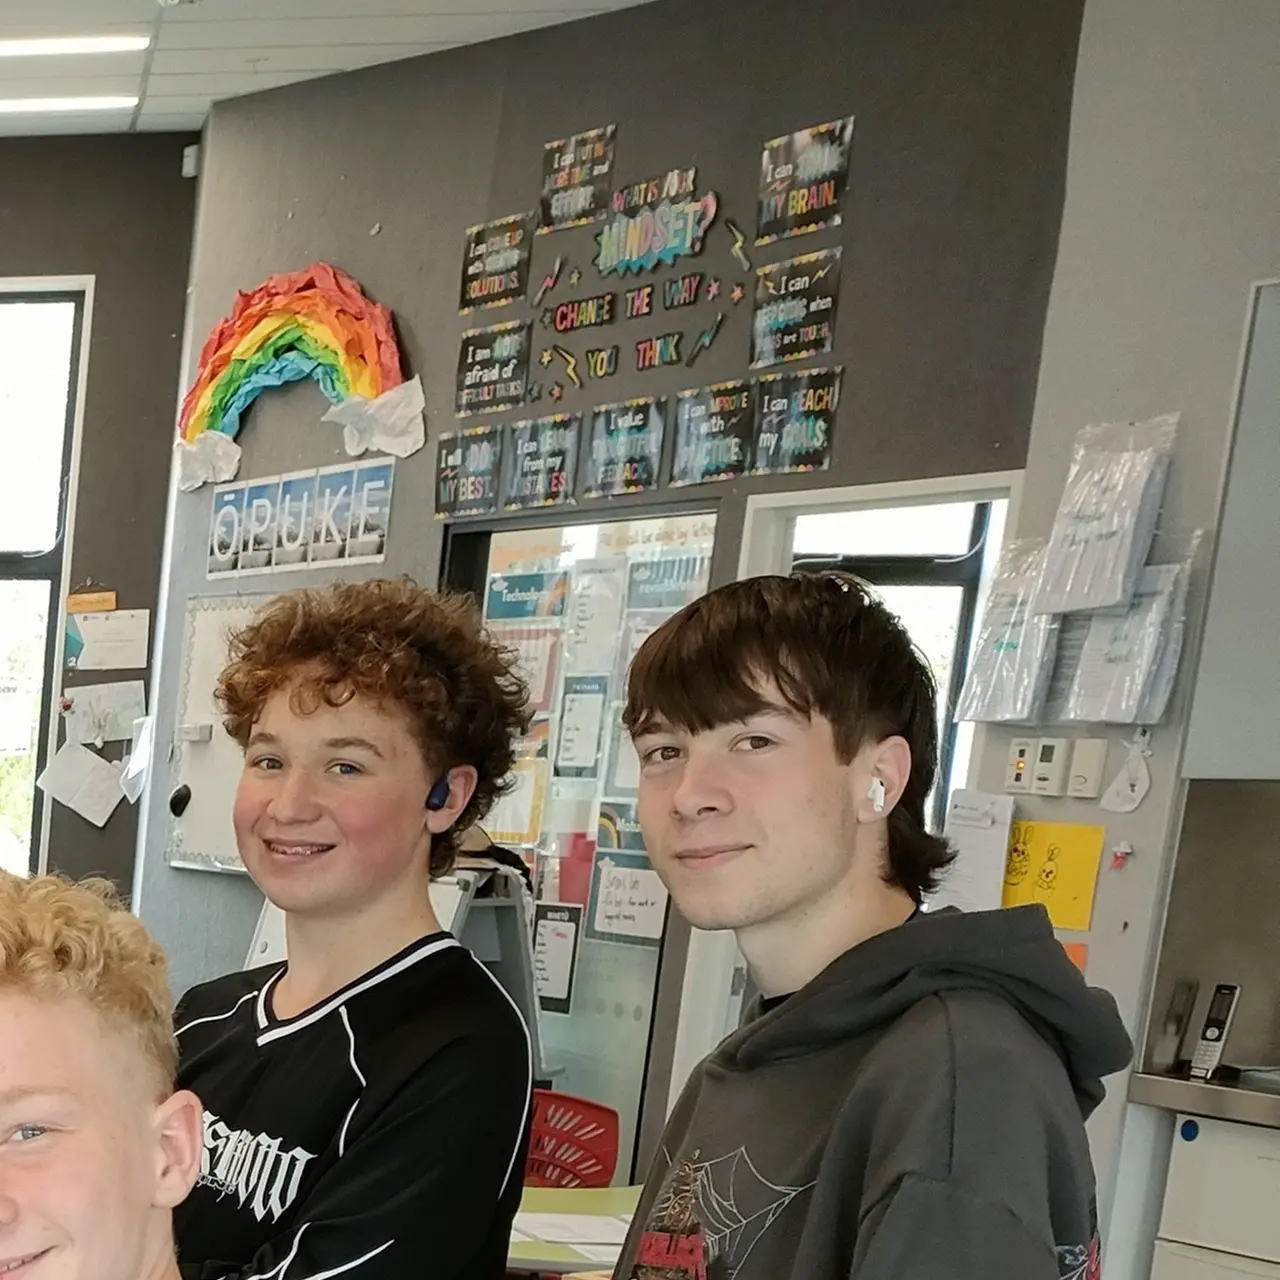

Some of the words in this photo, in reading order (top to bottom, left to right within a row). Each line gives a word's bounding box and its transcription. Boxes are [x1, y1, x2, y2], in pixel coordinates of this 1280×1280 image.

[774, 163, 793, 179] can
[787, 179, 837, 217] BRAIN.
[598, 190, 717, 270] MINDSET?
[788, 275, 810, 292] can
[555, 293, 614, 332] CHANGE
[626, 285, 653, 317] THE
[664, 275, 701, 308] WAY
[474, 347, 491, 362] am
[588, 349, 617, 377] YOU
[637, 334, 679, 369] THINK
[464, 363, 500, 385] afraid
[501, 359, 518, 378] of
[690, 404, 706, 418] can
[769, 397, 788, 411] can
[617, 411, 645, 427] value
[758, 431, 779, 455] my
[523, 455, 545, 472] from
[545, 455, 563, 471] my
